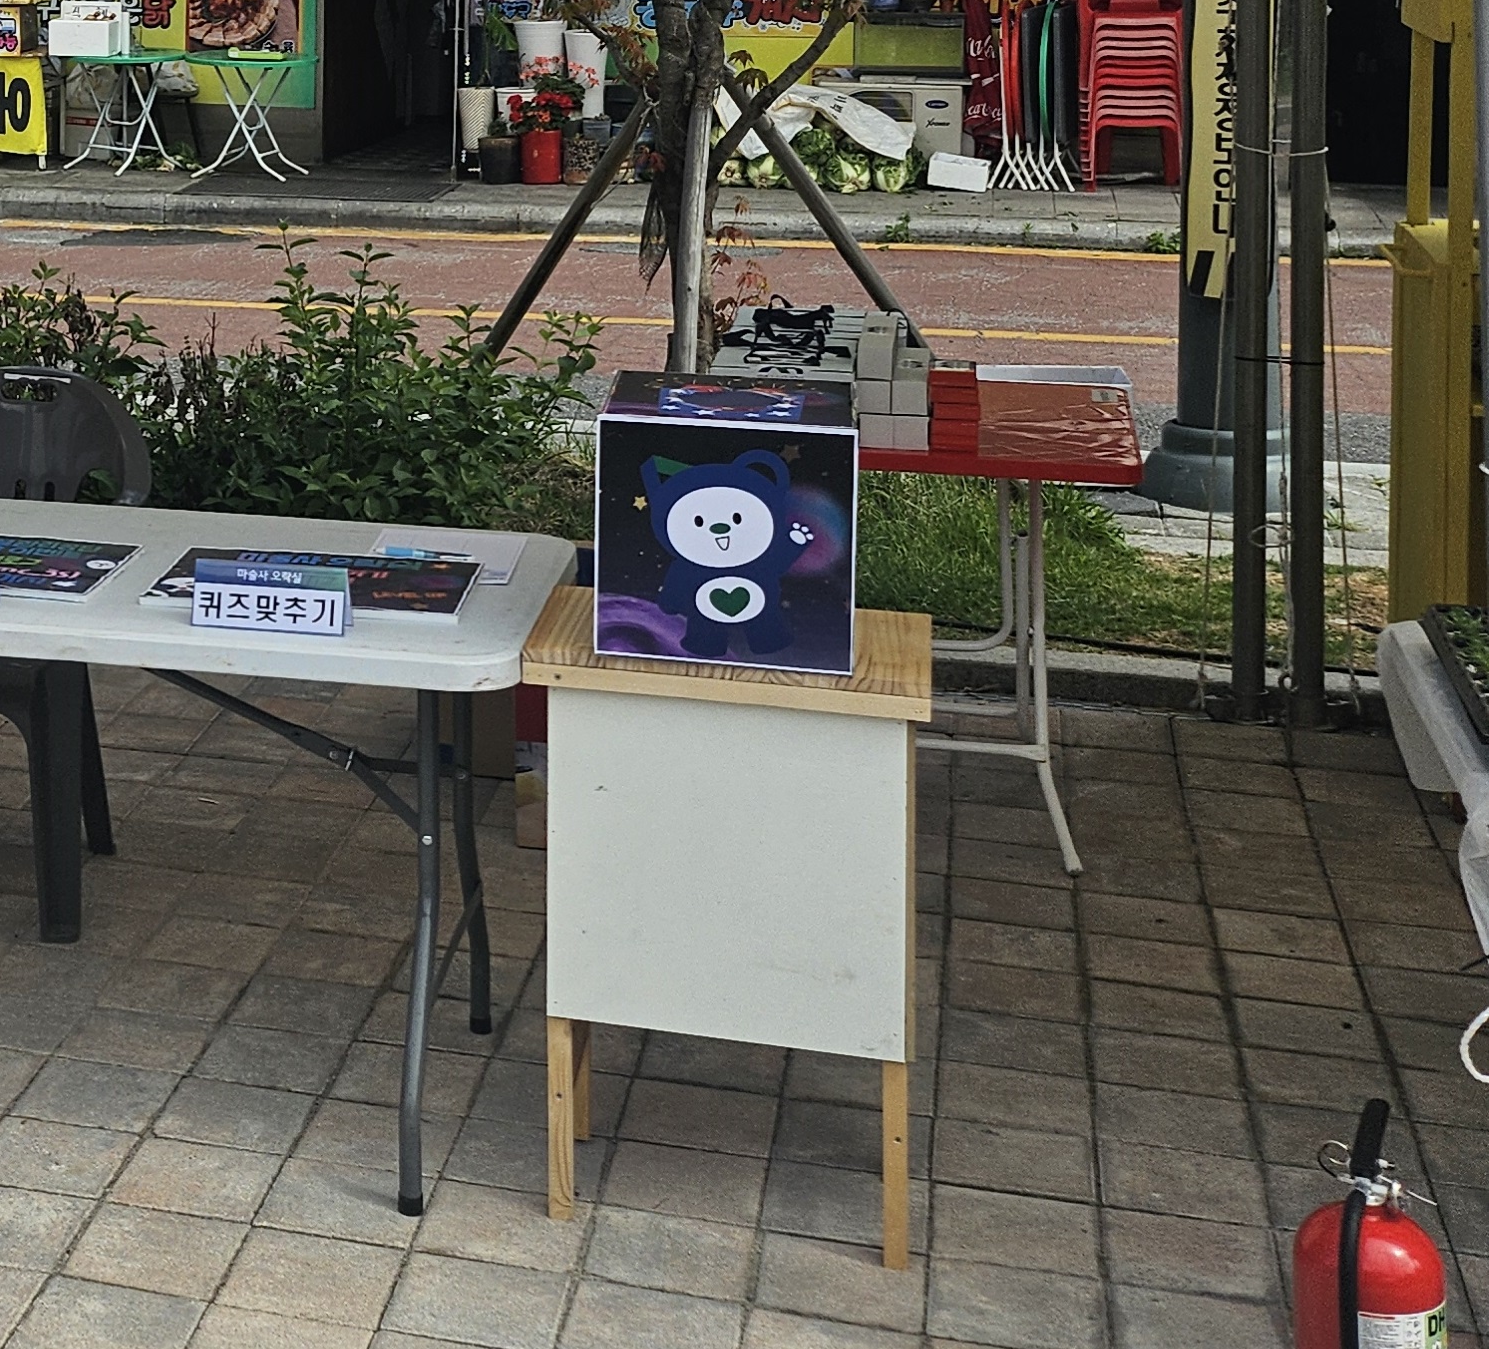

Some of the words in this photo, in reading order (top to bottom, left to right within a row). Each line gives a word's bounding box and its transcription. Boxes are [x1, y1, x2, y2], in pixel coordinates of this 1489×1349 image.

[237, 568, 268, 582] 마술사
[270, 570, 302, 585] 오락실
[198, 590, 336, 627] 퀴즈맞추기
